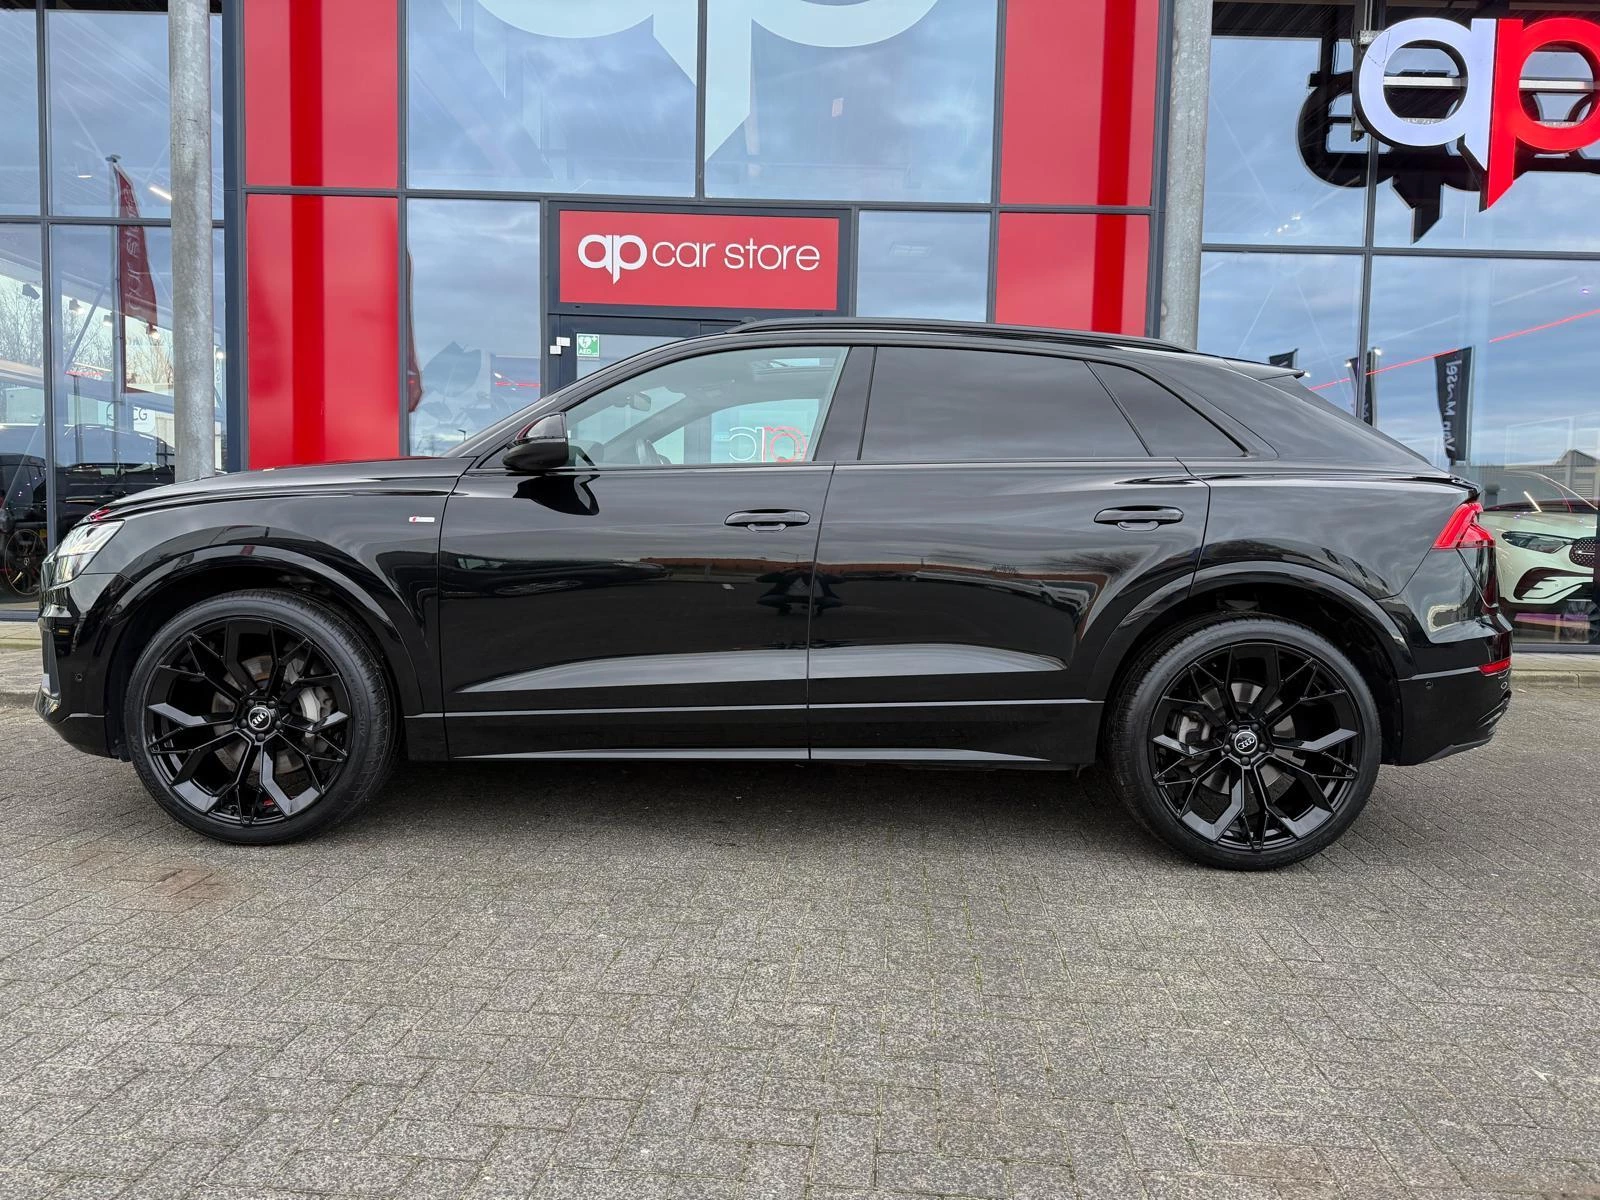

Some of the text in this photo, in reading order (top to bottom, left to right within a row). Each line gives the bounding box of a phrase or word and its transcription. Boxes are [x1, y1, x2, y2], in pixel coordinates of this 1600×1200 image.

[577, 234, 820, 284] ap car store
